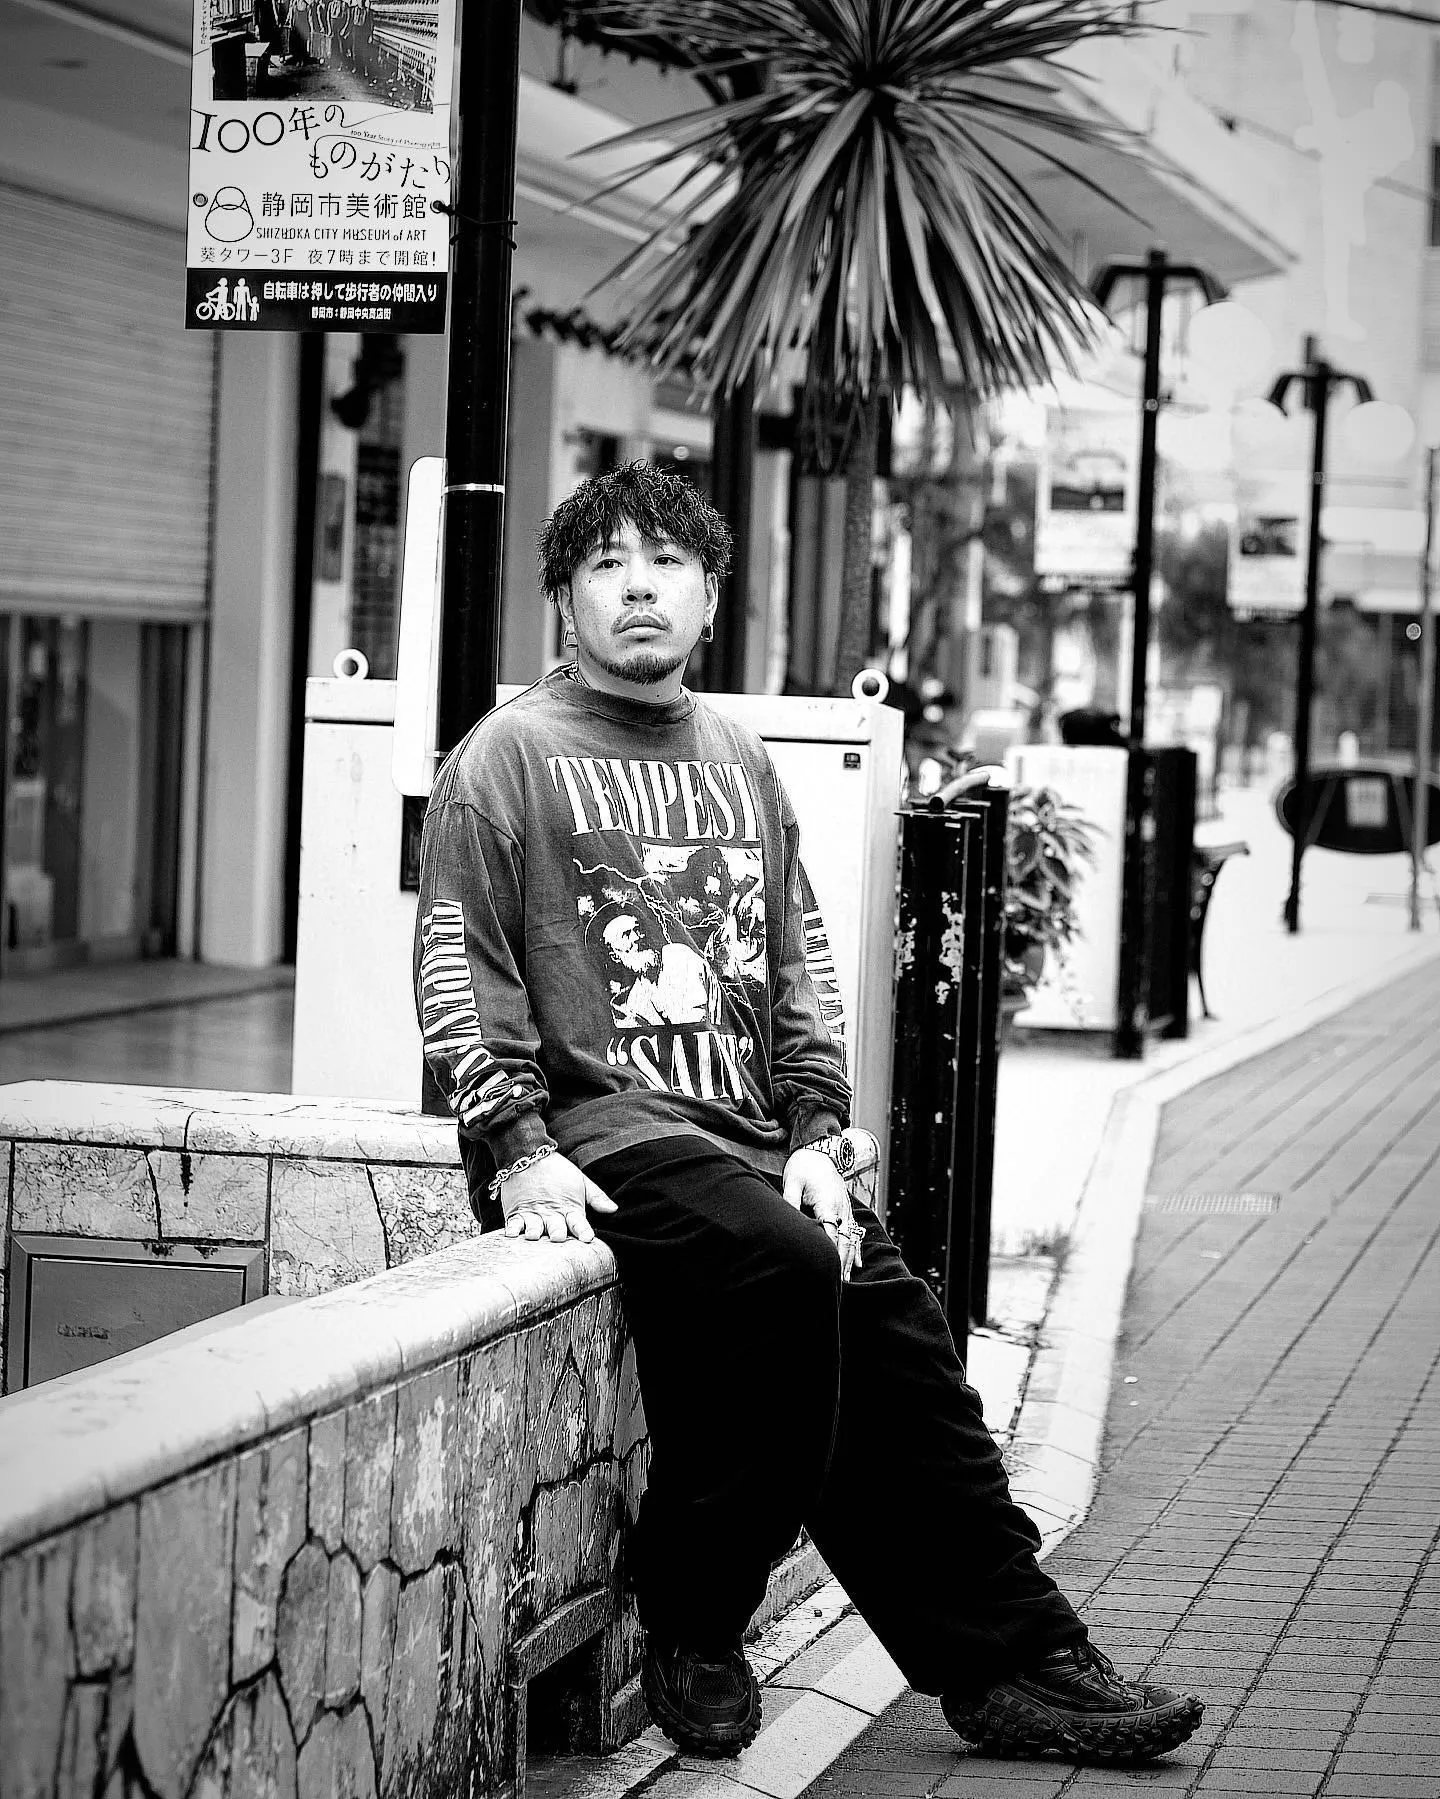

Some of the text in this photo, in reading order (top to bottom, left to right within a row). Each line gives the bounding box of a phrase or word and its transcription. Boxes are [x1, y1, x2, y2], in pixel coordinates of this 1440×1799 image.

[309, 141, 451, 189] ものがたり
[261, 191, 427, 220] 静岡市美術館
[256, 226, 428, 242] SHIZUOKA CITY MUSEUM of ART
[263, 280, 438, 303] 自転車は押して歩行者の仲間入り
[546, 755, 762, 842] TEMPEST
